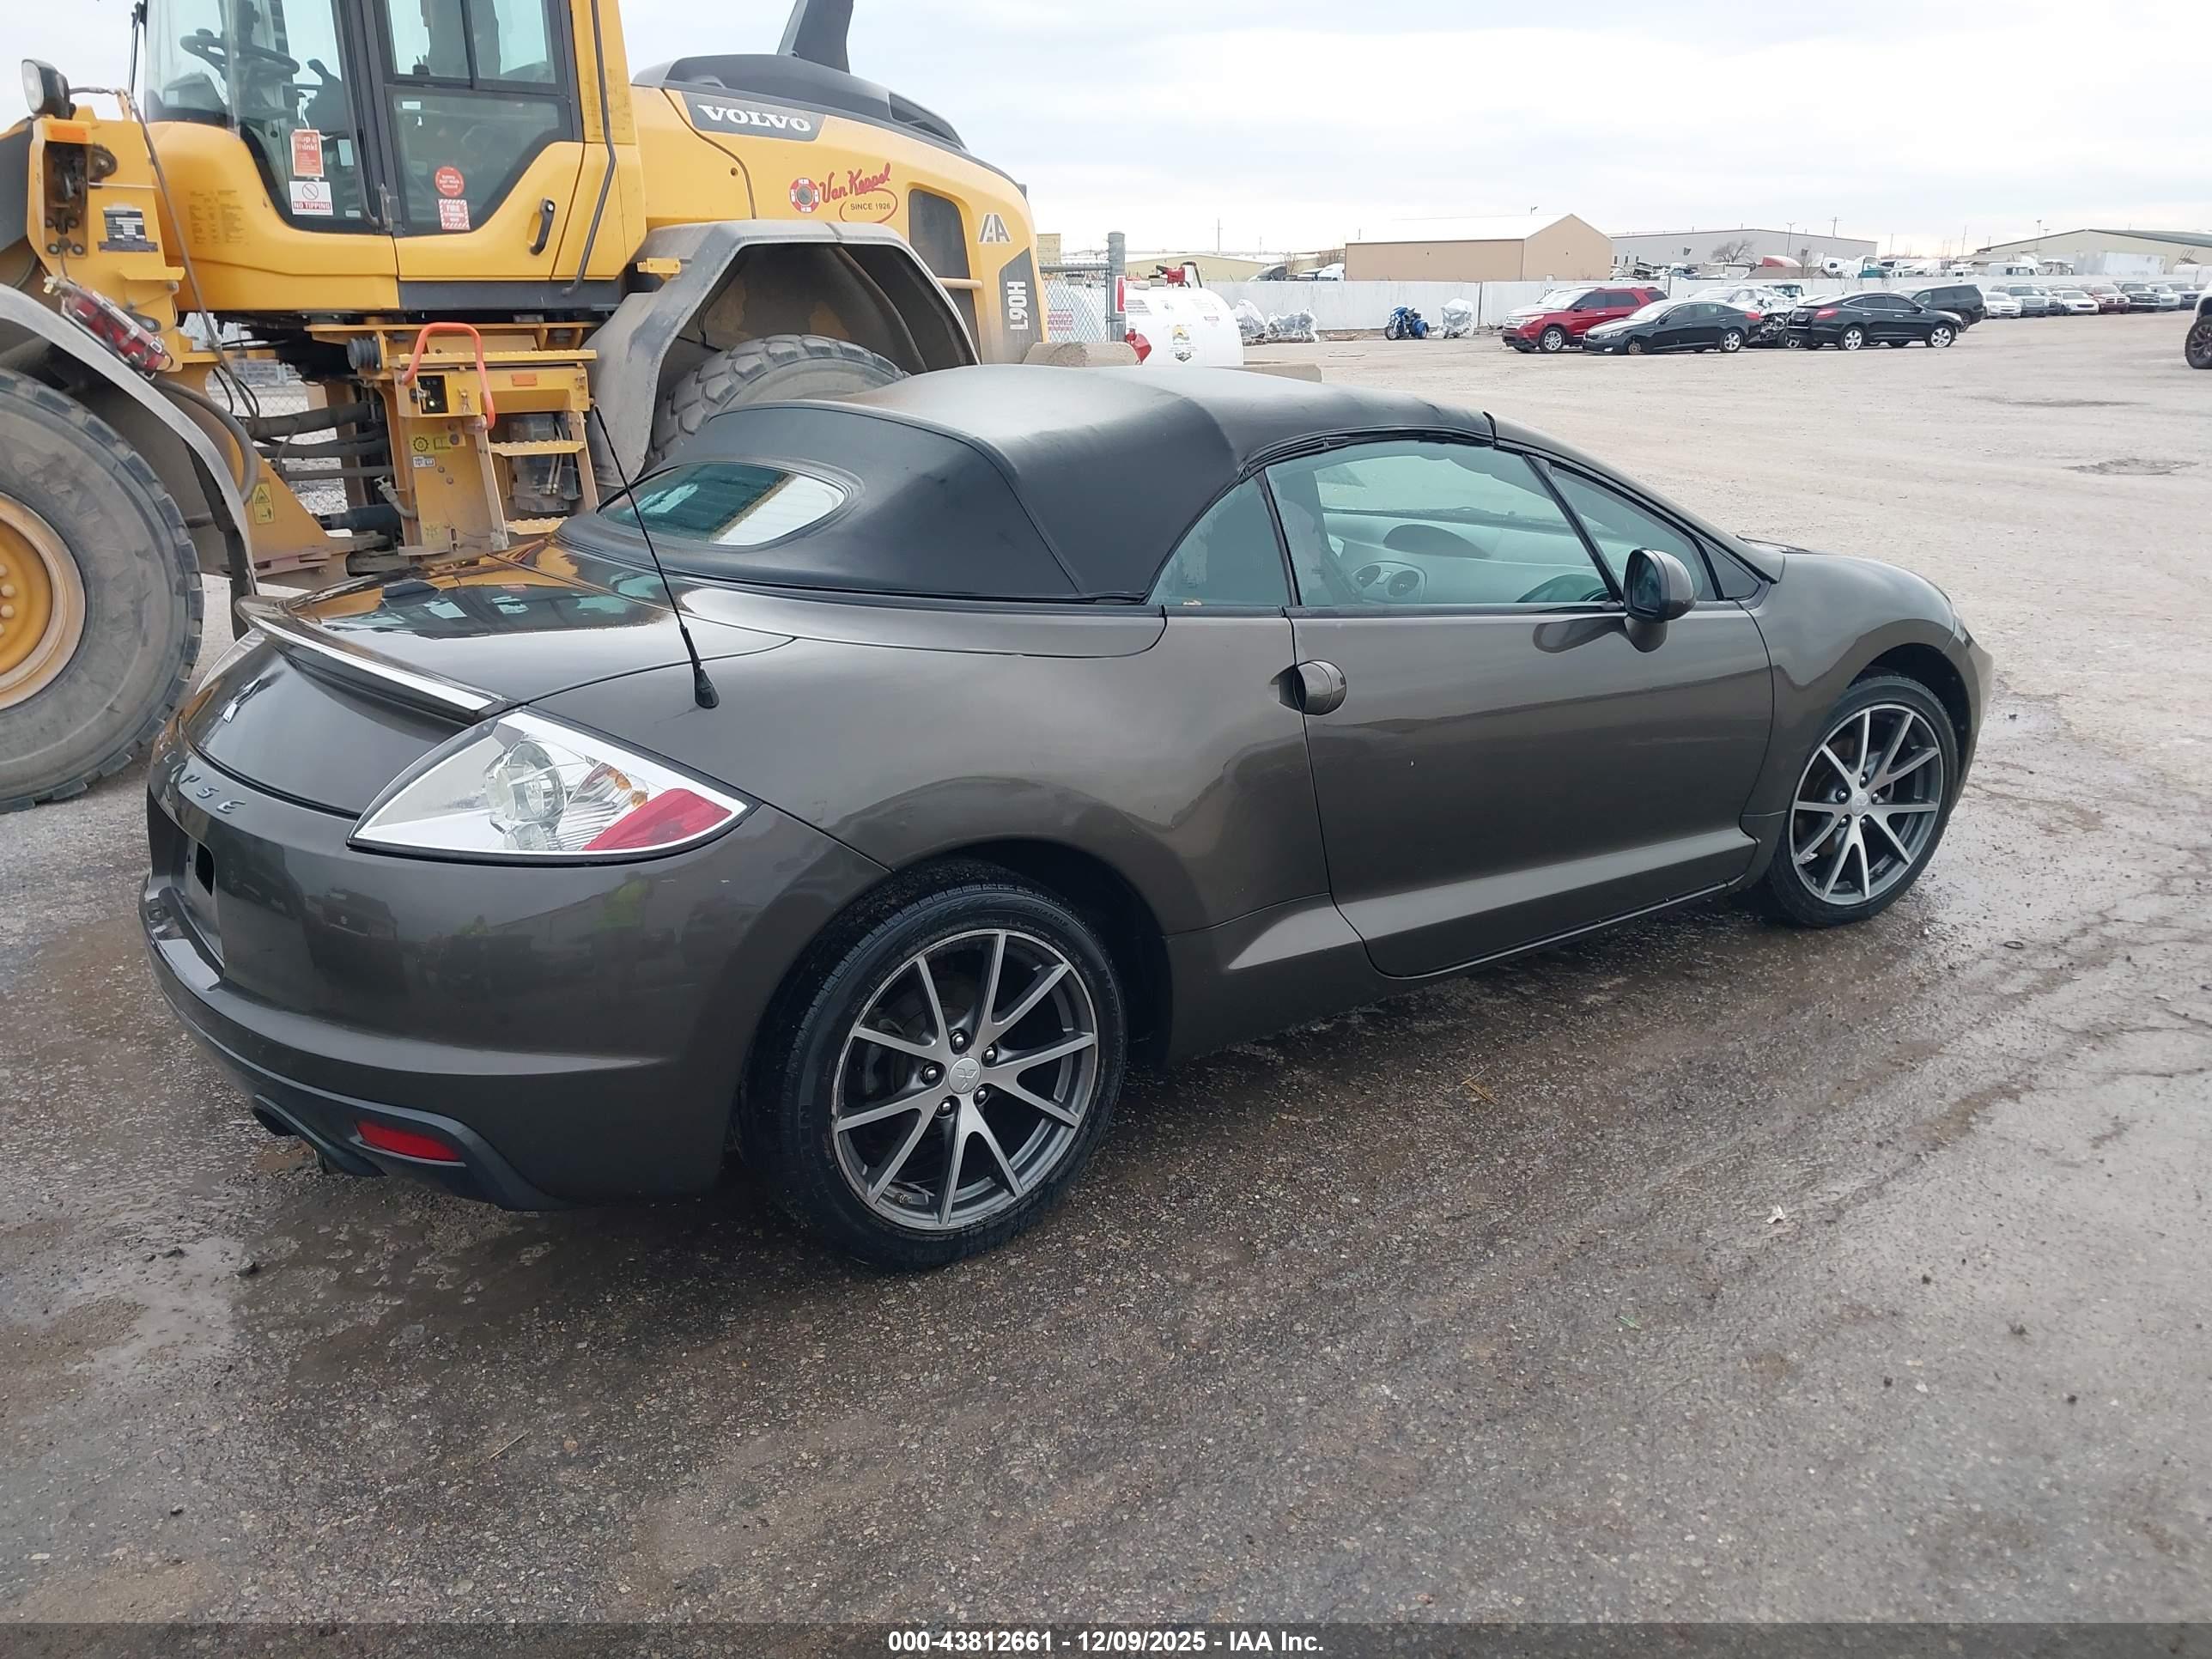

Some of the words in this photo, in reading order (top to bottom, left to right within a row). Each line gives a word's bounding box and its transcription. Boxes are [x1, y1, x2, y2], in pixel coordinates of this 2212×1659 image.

[697, 104, 811, 131] VOLVO
[819, 171, 848, 204] Van
[1006, 281, 1029, 331] L90H
